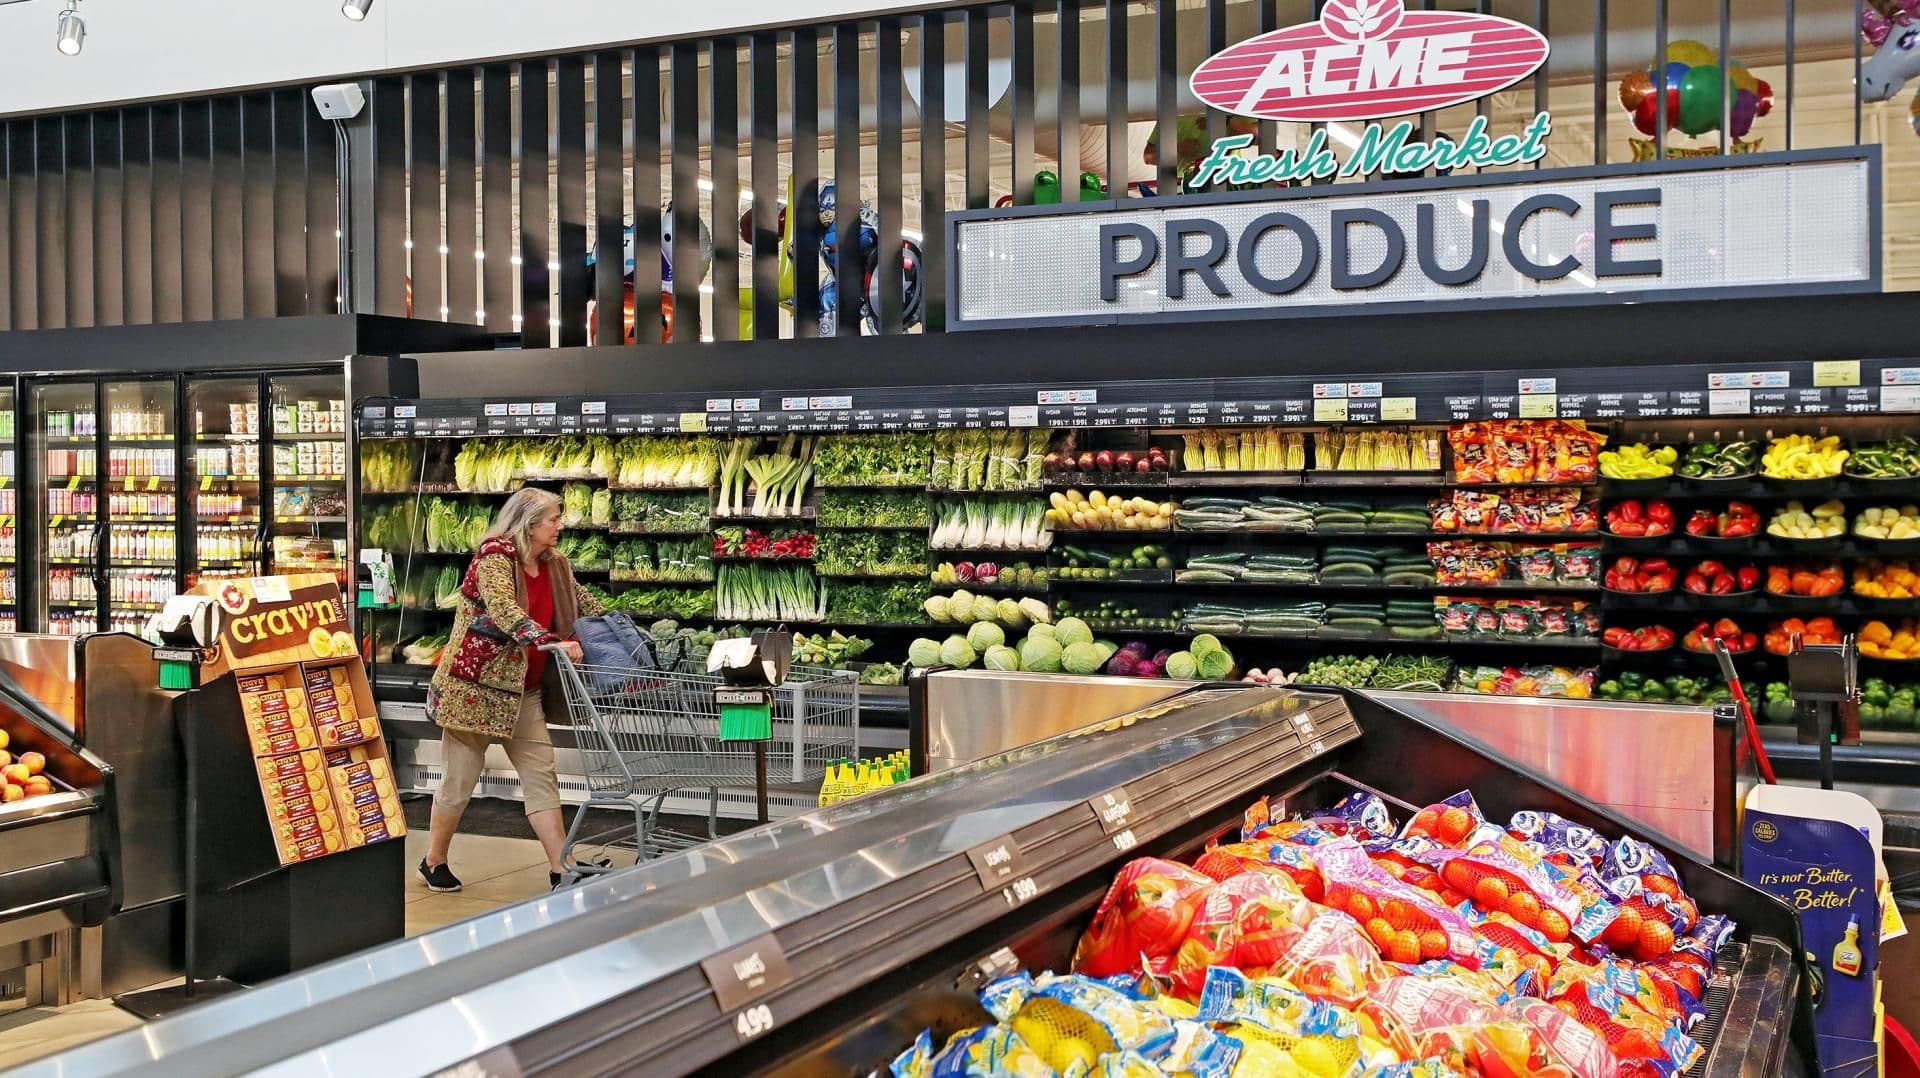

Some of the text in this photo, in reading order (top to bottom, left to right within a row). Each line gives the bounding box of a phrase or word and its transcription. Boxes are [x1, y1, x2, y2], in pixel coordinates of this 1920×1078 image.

[1235, 32, 1474, 114] ACME
[1189, 111, 1552, 187] Fresh Market
[1100, 187, 1662, 301] PRODUCE
[230, 599, 337, 644] crav'n
[1760, 867, 1853, 885] It's not Butter.
[1793, 887, 1857, 910] Better!
